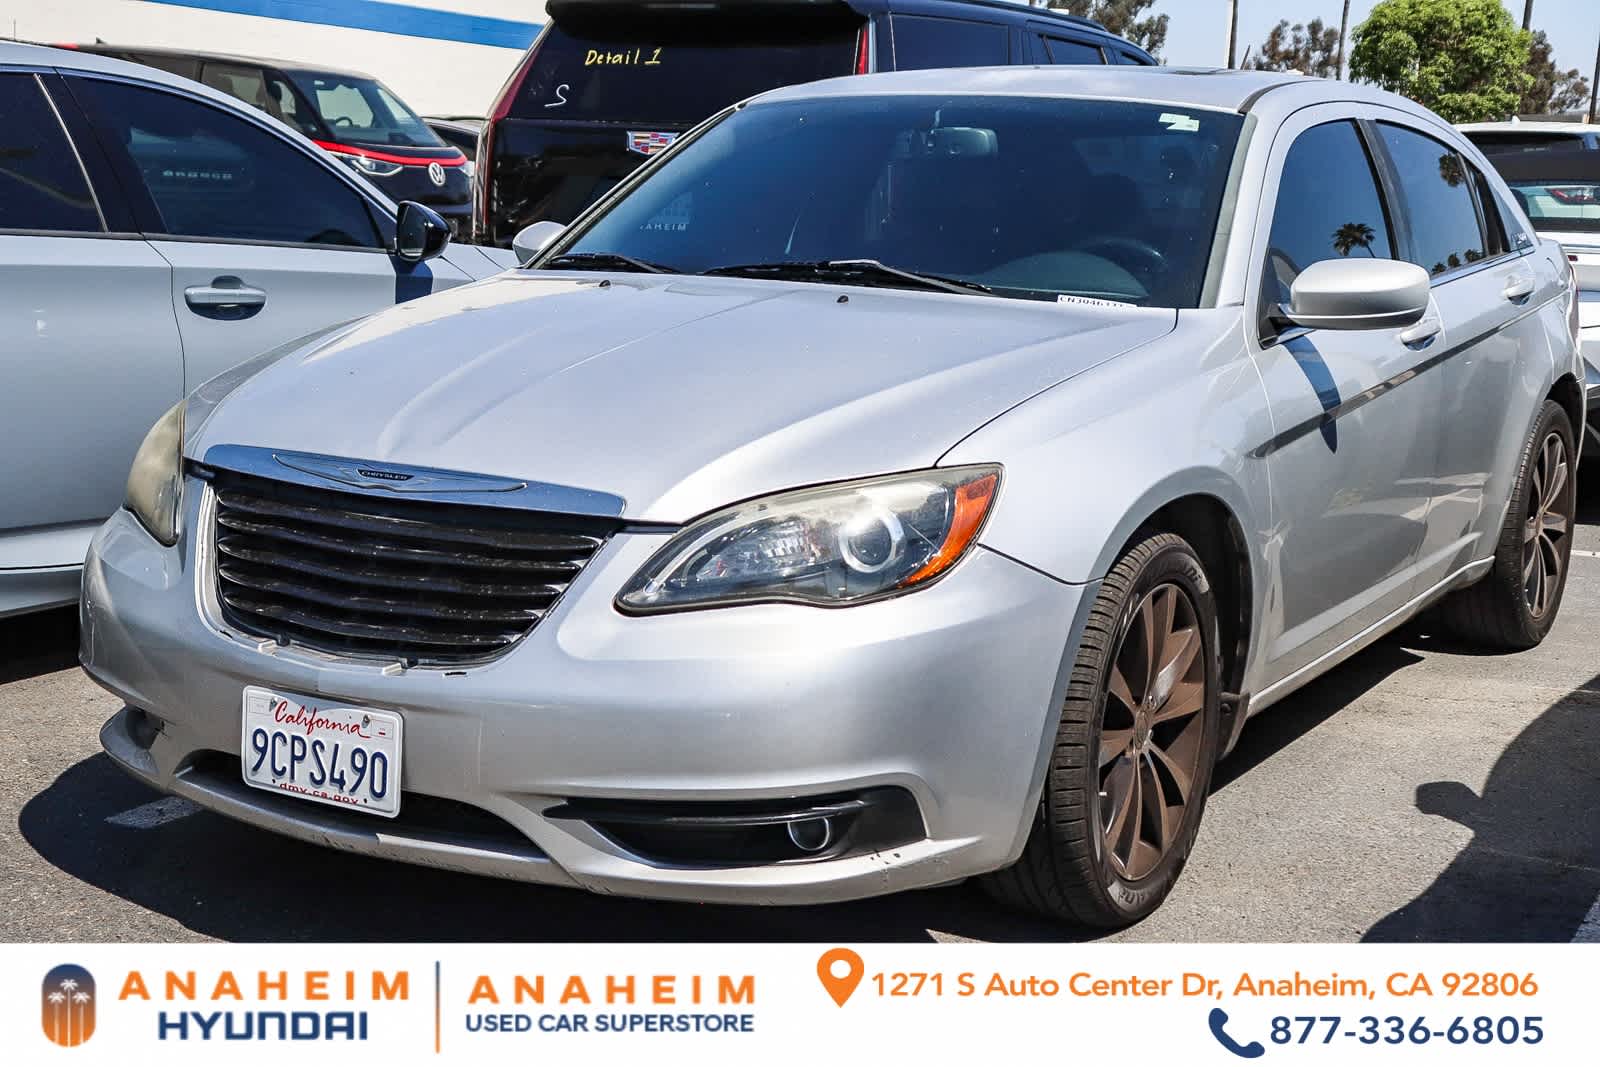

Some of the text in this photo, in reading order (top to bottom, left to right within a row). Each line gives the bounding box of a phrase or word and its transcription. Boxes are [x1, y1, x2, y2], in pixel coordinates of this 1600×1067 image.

[584, 46, 662, 66] Detail 1
[360, 470, 408, 480] CHRYSLER
[274, 700, 372, 739] California
[251, 727, 388, 799] 9CPS490
